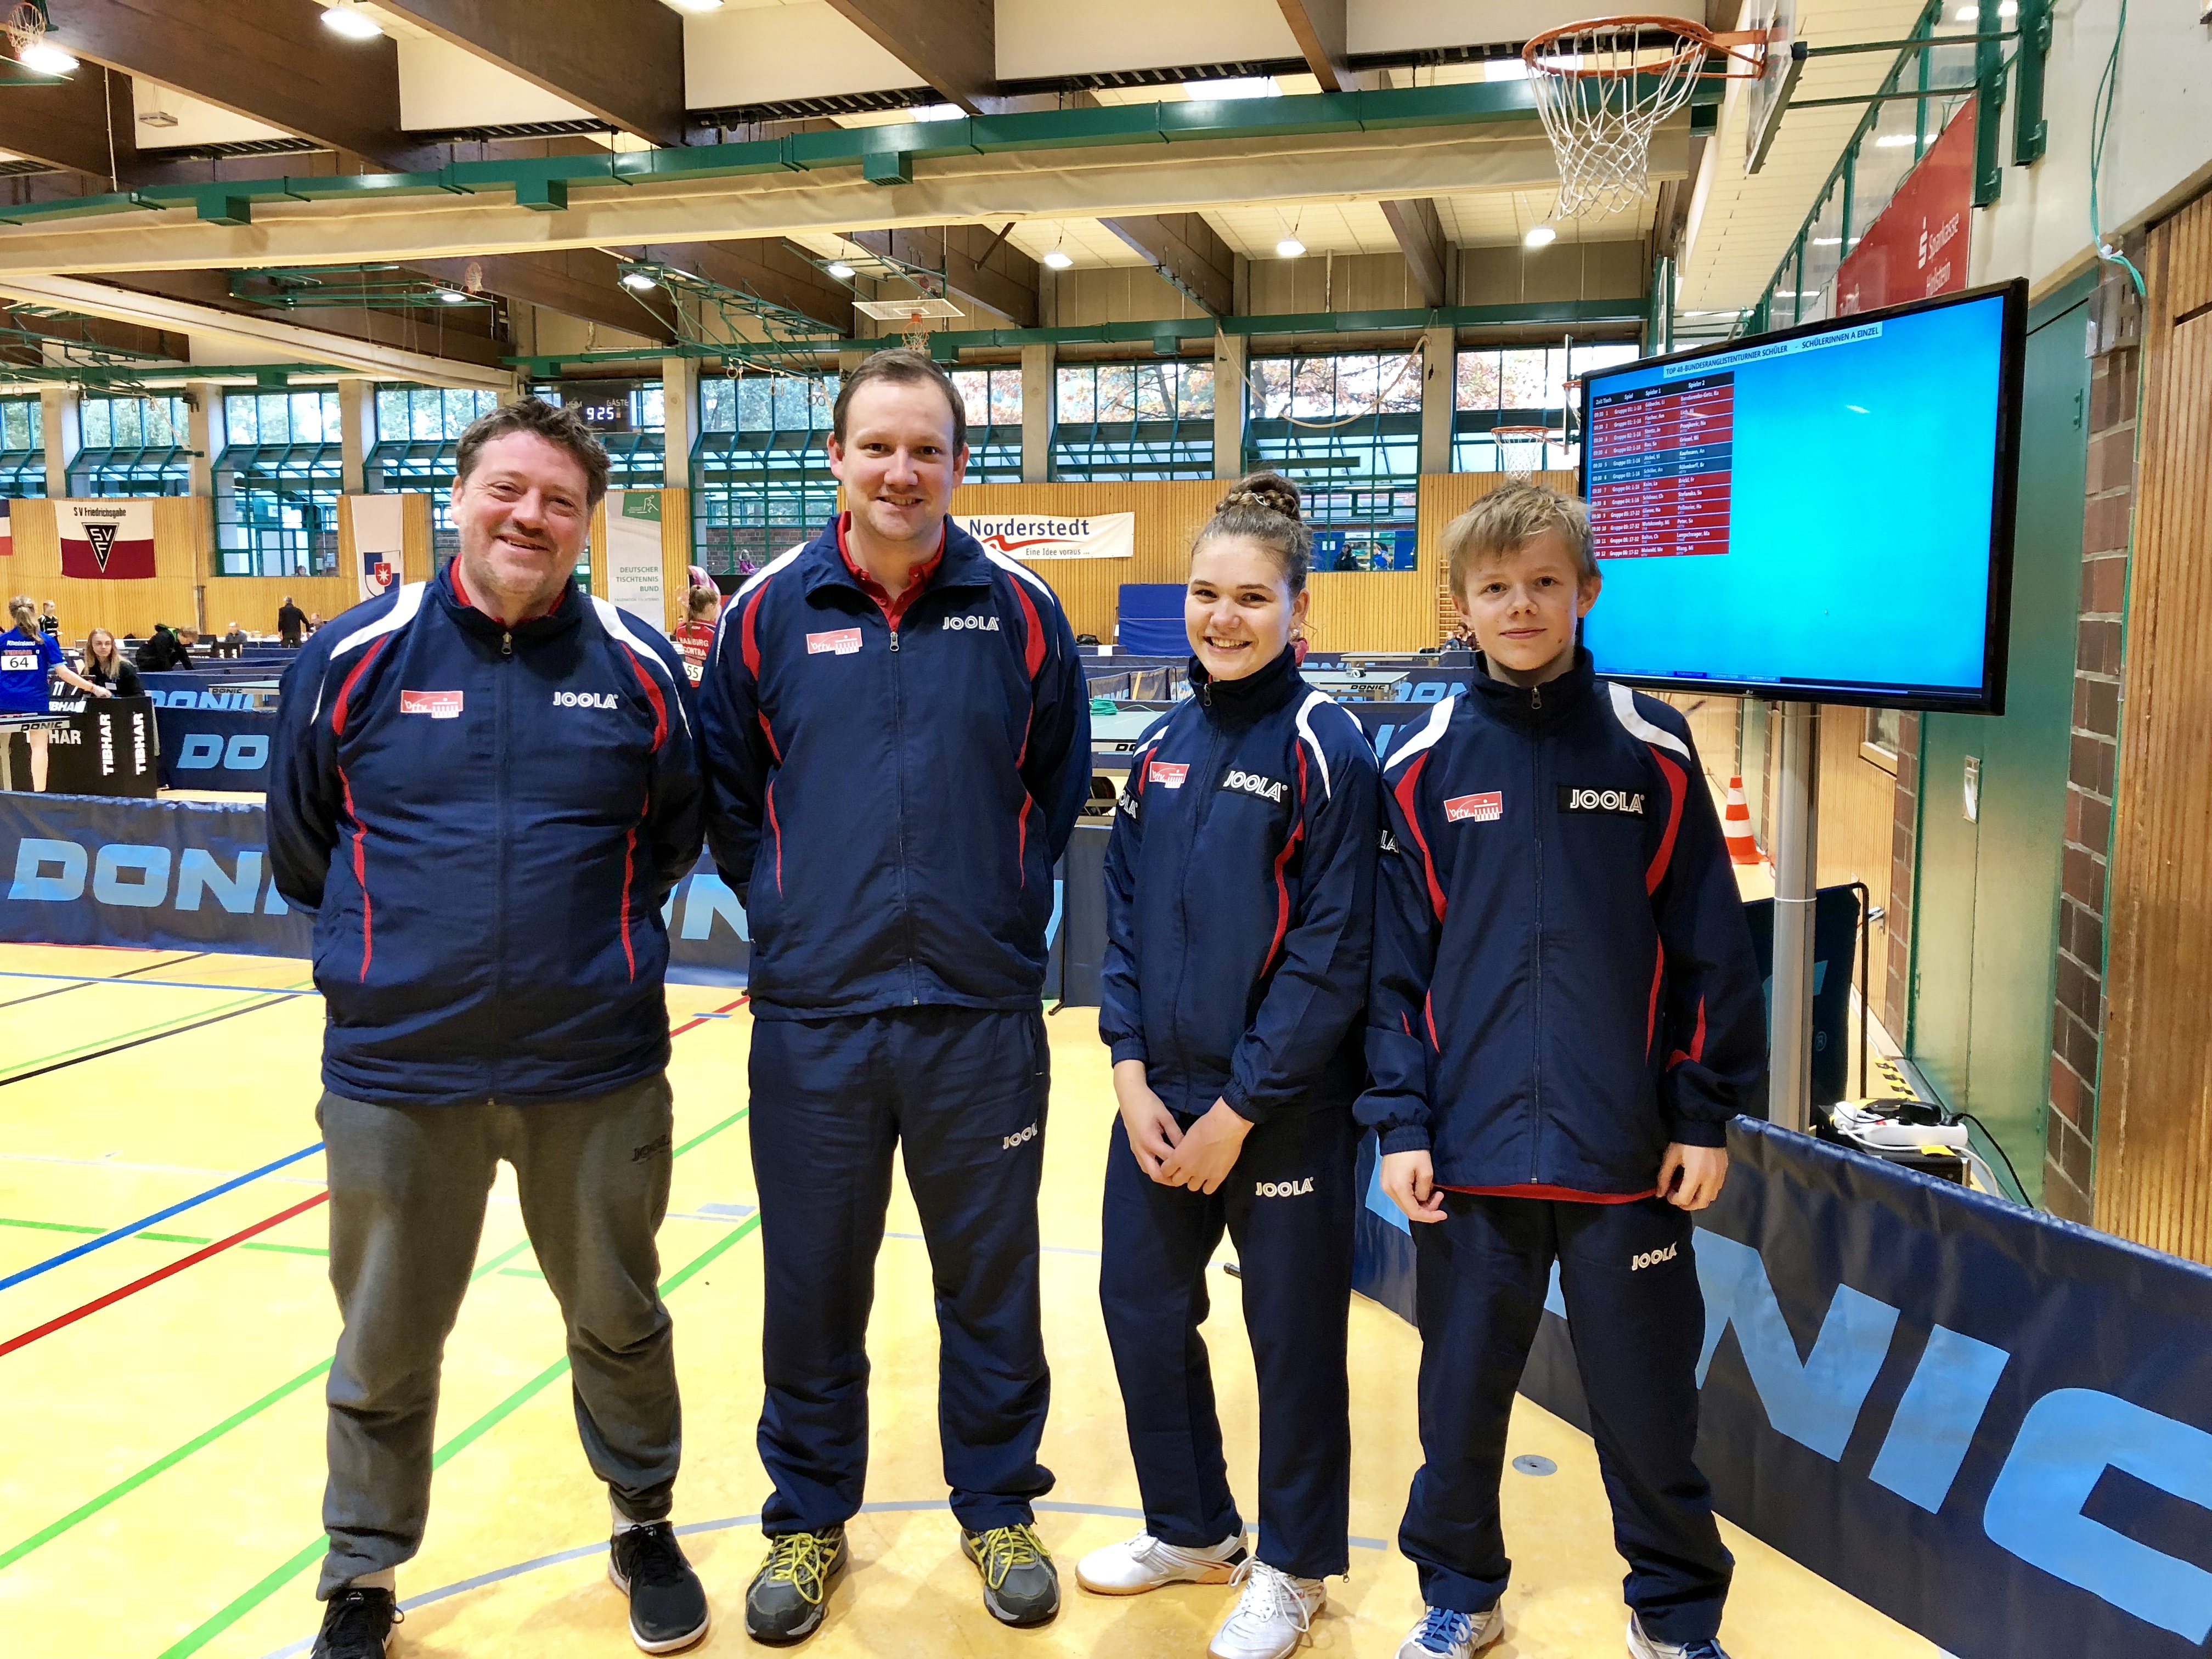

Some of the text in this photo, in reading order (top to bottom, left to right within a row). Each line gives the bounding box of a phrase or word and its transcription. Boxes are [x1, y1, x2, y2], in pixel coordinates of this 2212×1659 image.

[1928, 213, 1959, 262] Sparkasse
[1677, 351, 1761, 373] 48-BUNDESRANGLISTENTURNIER
[1762, 345, 1787, 357] SCHÜLER
[1802, 334, 1849, 349] SCHÜLERINNEN
[1857, 327, 1879, 337] EINZEL
[74, 507, 126, 518] S V Friedrichsgabe
[90, 528, 112, 541] SV
[969, 518, 1090, 536] Norderstedt
[95, 542, 108, 560] F
[943, 616, 1000, 631] JOOLA
[684, 647, 707, 656] CONTRA
[10, 657, 29, 668] 64
[687, 665, 698, 679] 55
[553, 692, 618, 709] JOOLA
[20, 721, 63, 731] DONIC
[22, 730, 81, 744] THAR
[100, 713, 114, 776] TIBHAR
[133, 713, 147, 775] TIBHAR
[1223, 770, 1283, 803] JOOLA
[1570, 789, 1644, 814] JOOLA
[1256, 1178, 1314, 1197] JOOLA
[1632, 1242, 1677, 1271] JOOLA
